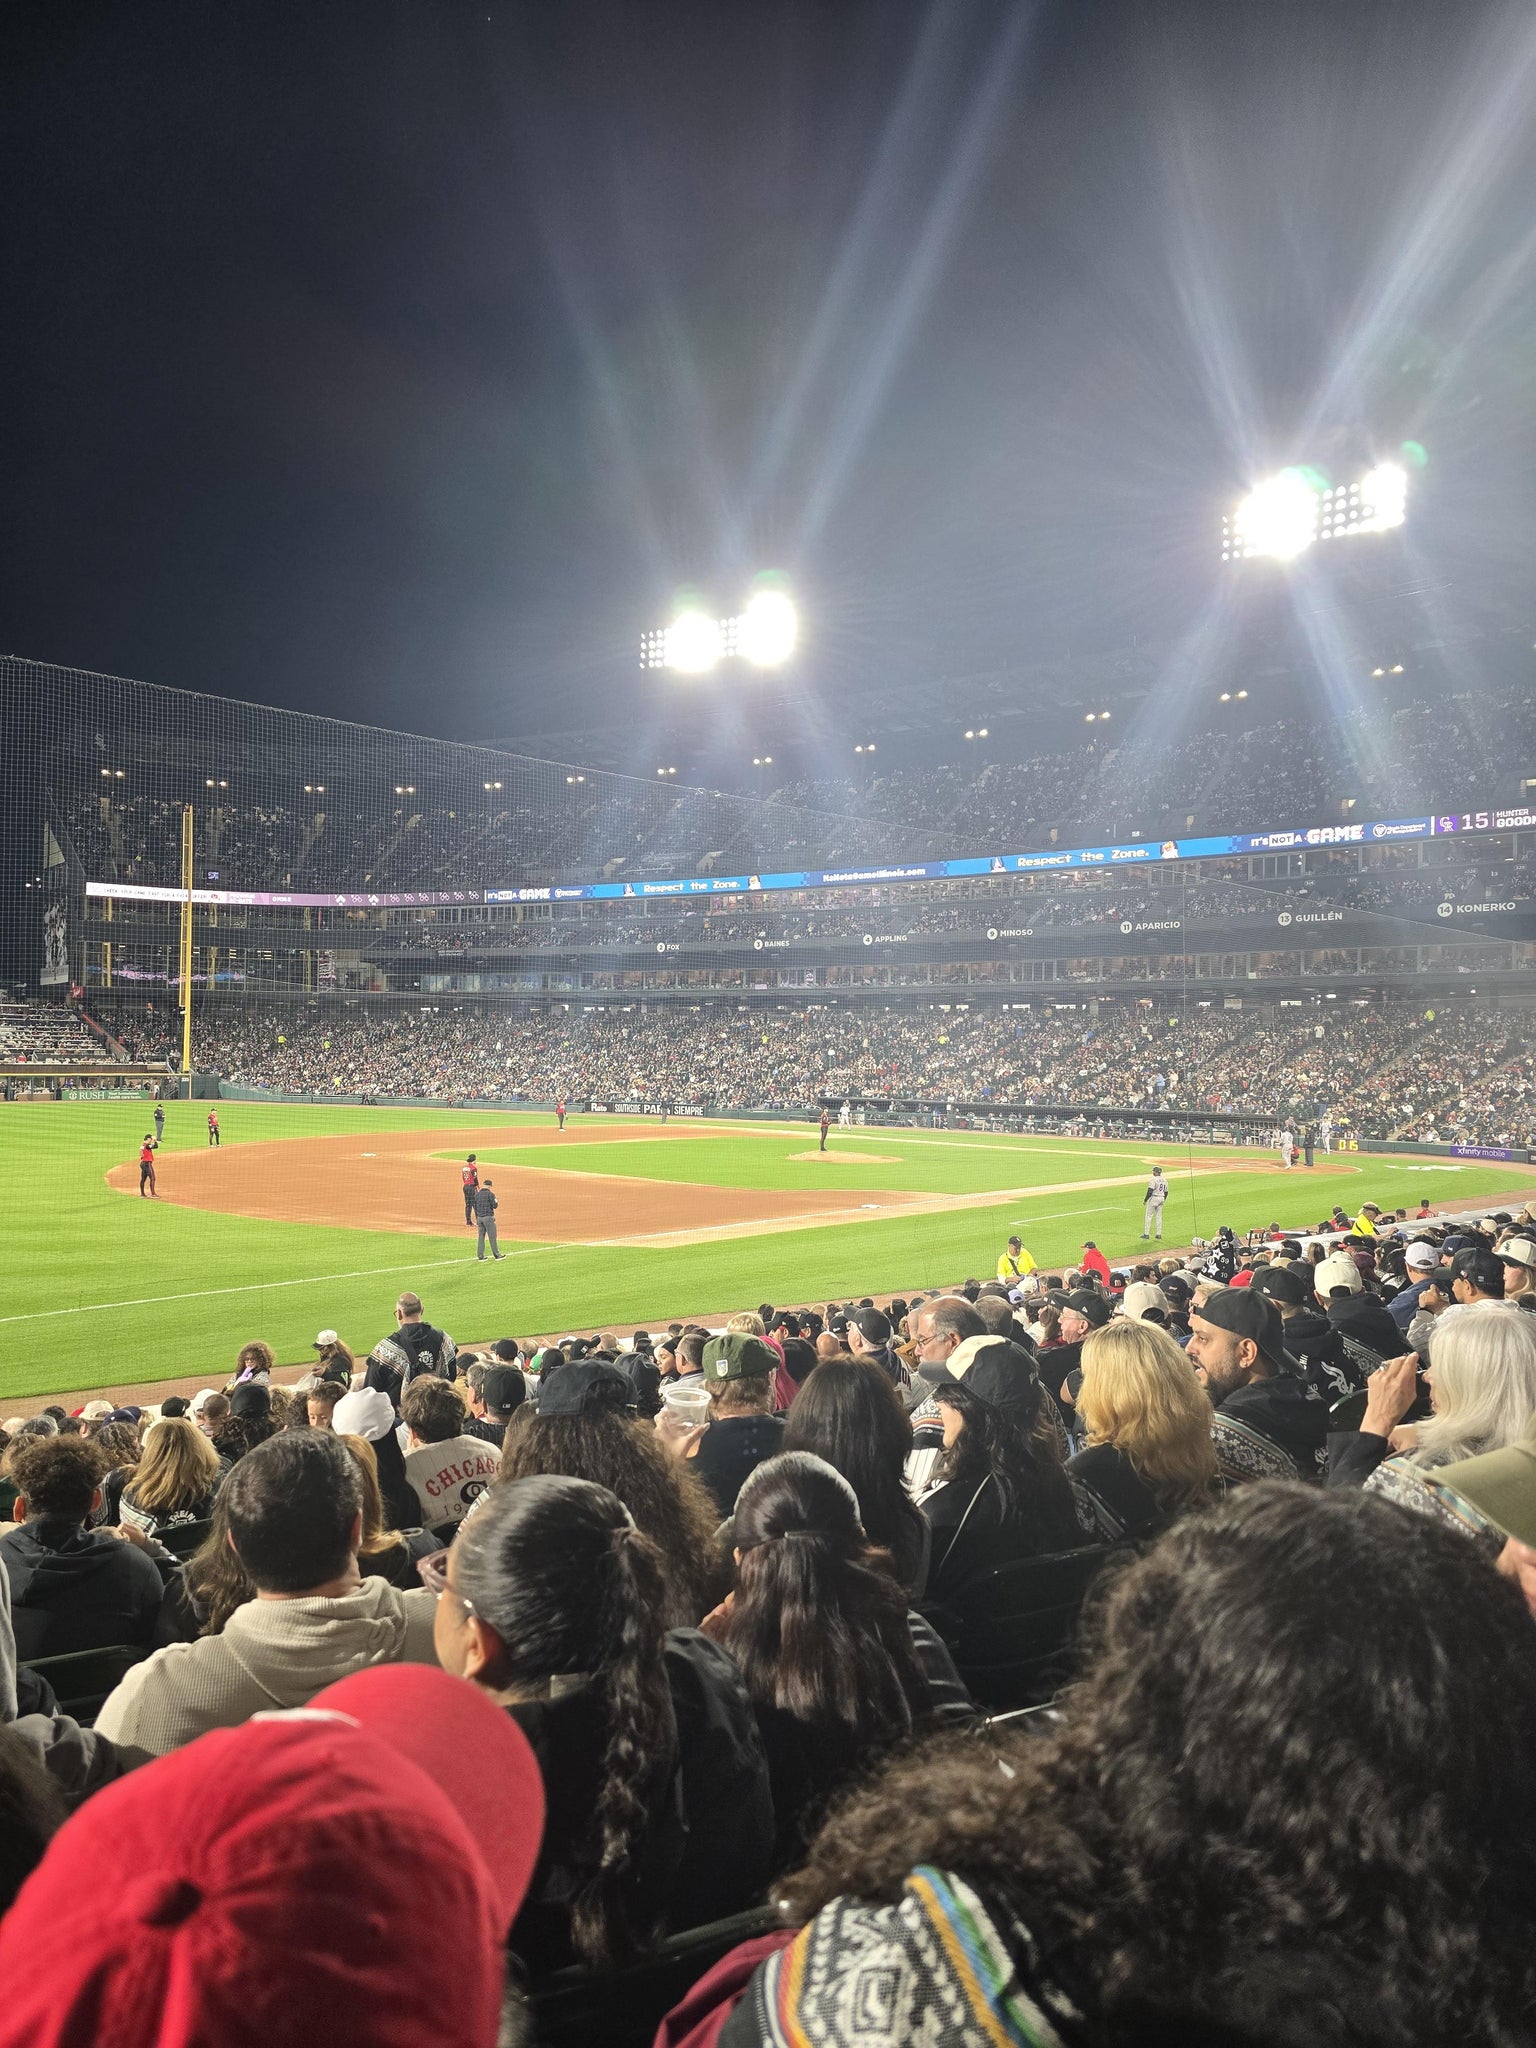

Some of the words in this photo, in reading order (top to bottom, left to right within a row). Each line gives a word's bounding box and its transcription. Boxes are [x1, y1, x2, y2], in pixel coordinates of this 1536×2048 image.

[1497, 808, 1529, 817] HUNTER
[1462, 812, 1488, 830] 15
[1294, 834, 1303, 843] A
[1306, 824, 1364, 845] GAME
[1017, 854, 1072, 868] Respect
[1080, 851, 1105, 862] the
[1111, 848, 1149, 860] Zone.
[643, 882, 684, 893] Respect
[690, 881, 708, 891] the
[712, 879, 741, 889] Zone.
[519, 887, 550, 900] GAME
[1456, 902, 1516, 913] KONERKO
[1295, 911, 1343, 922] GUILLÉN
[1135, 921, 1181, 931] APARICIO
[1000, 928, 1033, 937] MINOSO
[764, 940, 790, 948] BAINES
[874, 935, 908, 943] APPLING
[79, 1091, 105, 1100] RUSH
[614, 1103, 641, 1114] SOUTHSIDE
[674, 1105, 704, 1116] SIEMPRE
[1457, 1147, 1481, 1157] xfinity
[1482, 1148, 1506, 1158] mobile
